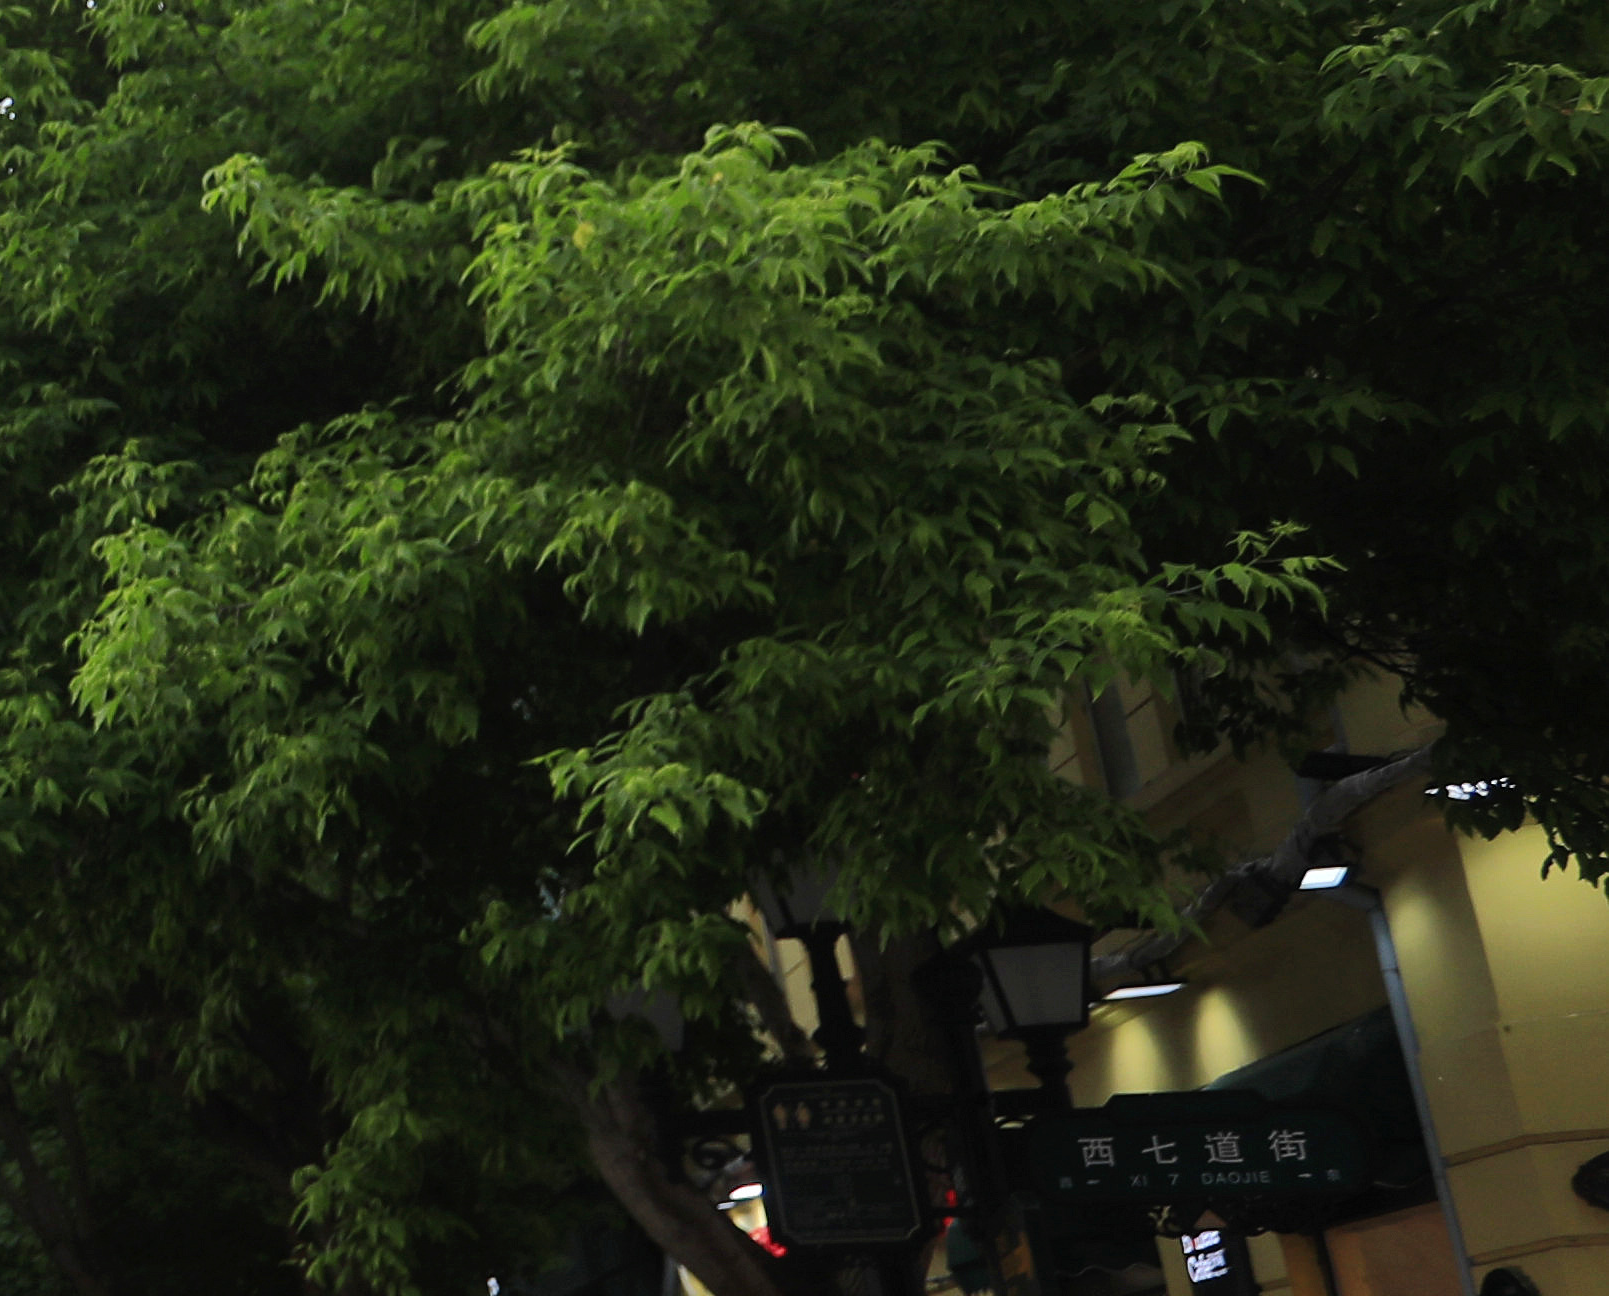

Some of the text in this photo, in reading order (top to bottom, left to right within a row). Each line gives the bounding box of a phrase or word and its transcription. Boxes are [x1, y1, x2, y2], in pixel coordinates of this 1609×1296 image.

[1077, 1130, 1308, 1168] 西七道街
[1200, 1170, 1271, 1186] DAOJIE
